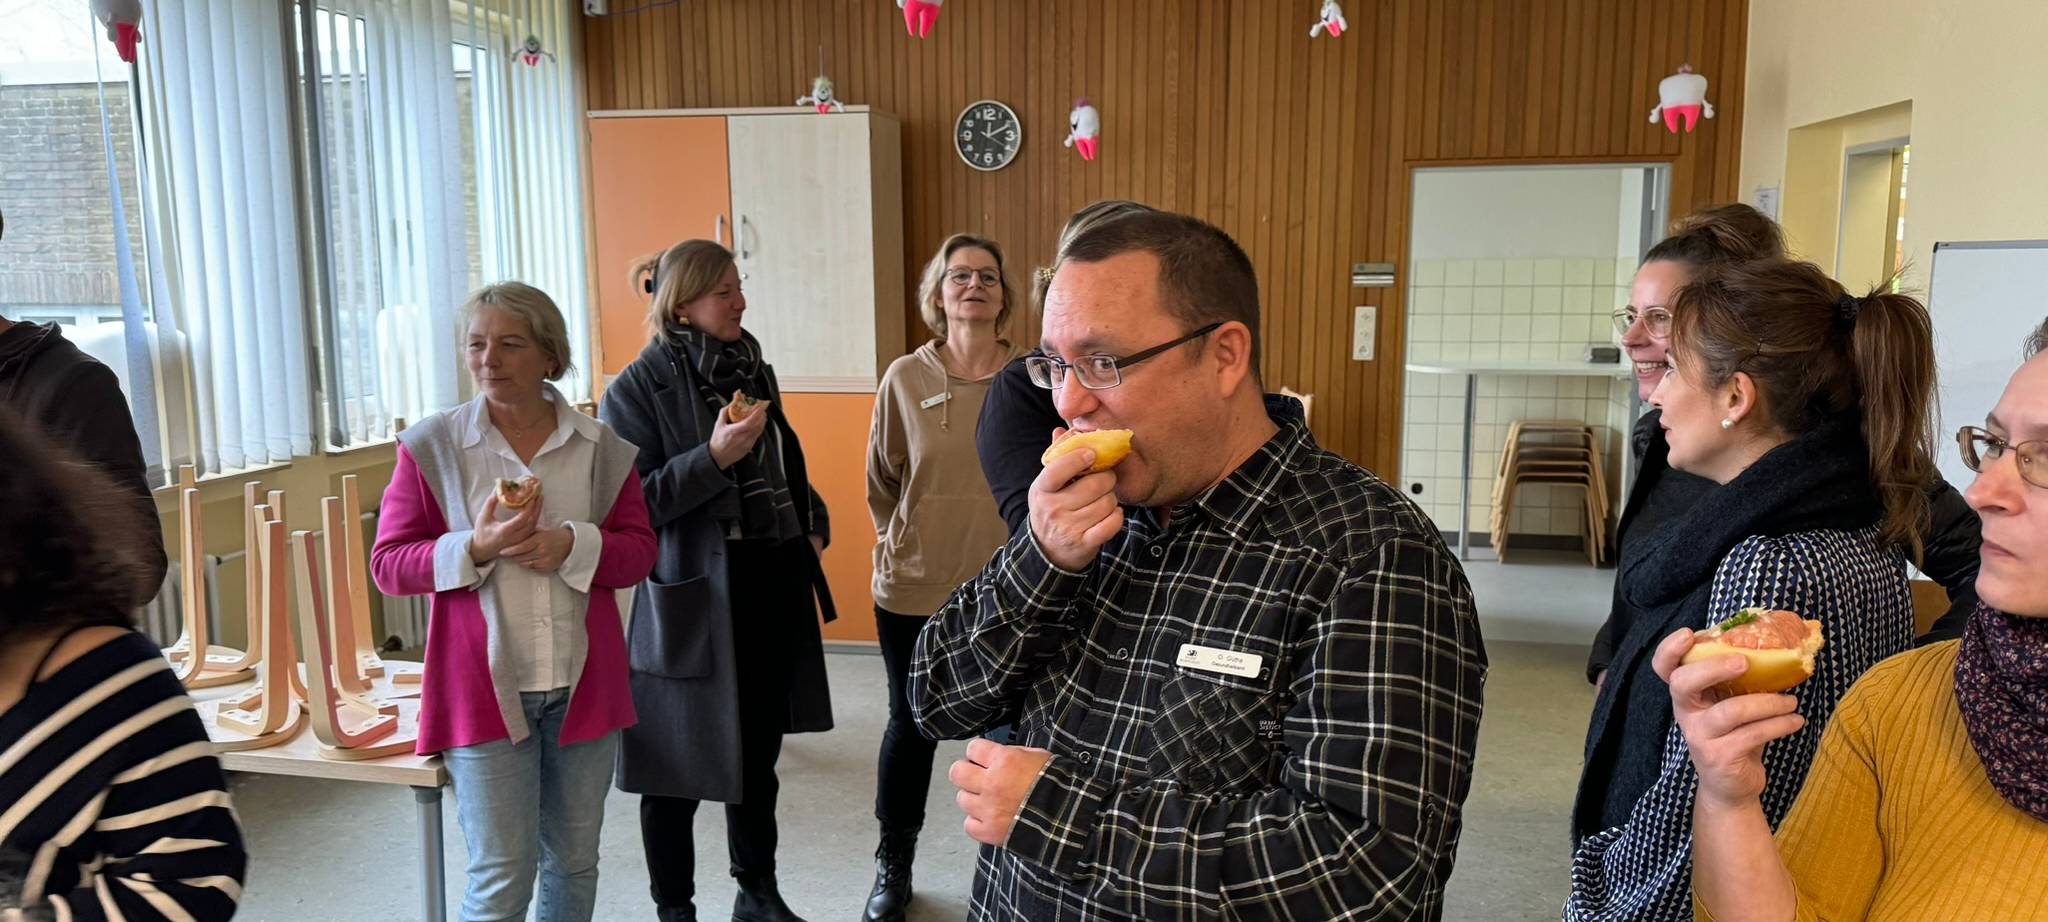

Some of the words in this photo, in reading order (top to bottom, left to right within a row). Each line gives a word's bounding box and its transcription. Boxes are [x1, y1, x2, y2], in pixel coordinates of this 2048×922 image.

[983, 108, 996, 120] 12
[963, 130, 972, 141] 9
[1004, 130, 1015, 141] 3
[984, 152, 993, 163] 6
